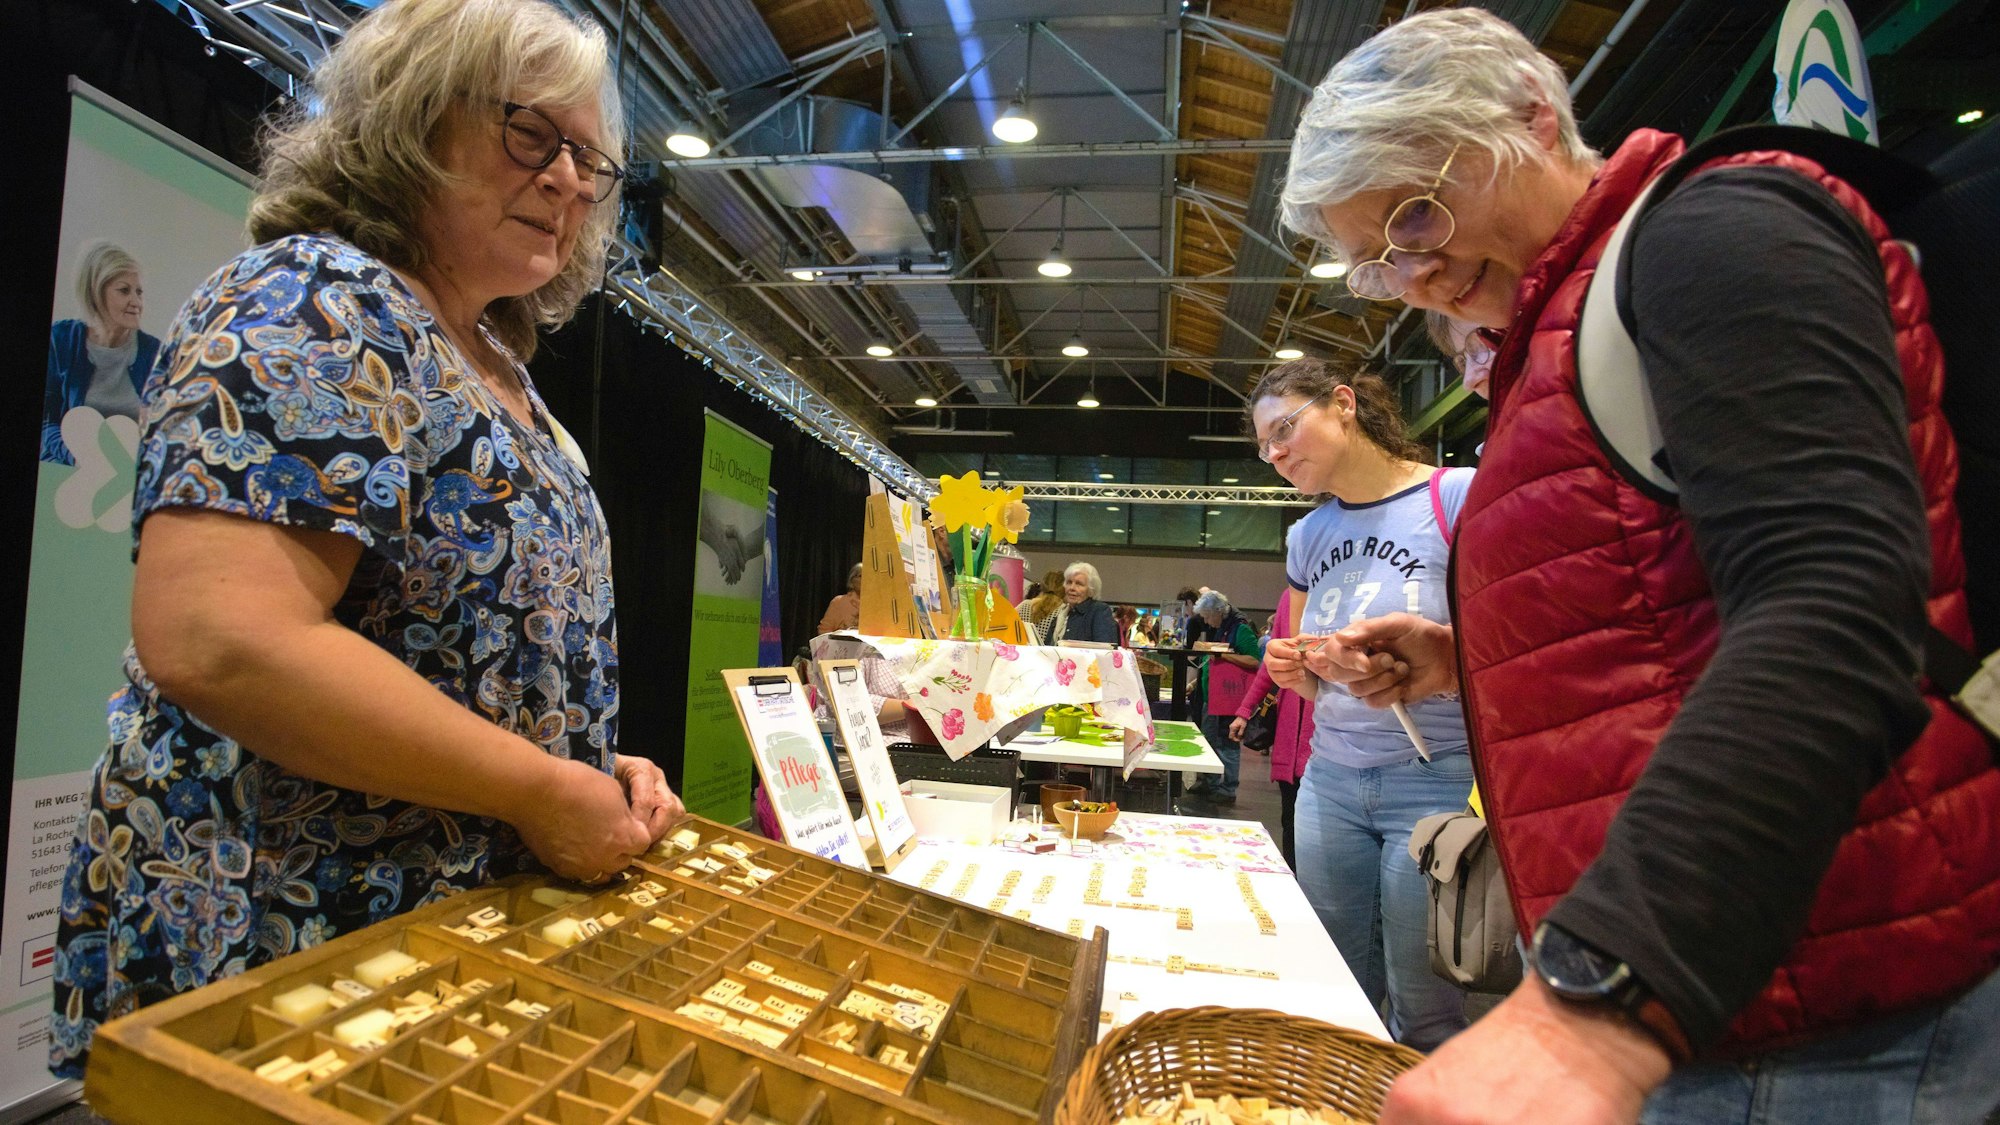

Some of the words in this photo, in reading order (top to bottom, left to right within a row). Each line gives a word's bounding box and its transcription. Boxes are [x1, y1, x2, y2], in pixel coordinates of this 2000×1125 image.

[709, 449, 726, 479] Lily
[728, 459, 764, 495] Oberberg
[1311, 539, 1353, 588] HARD
[1363, 536, 1426, 579] ROCK
[779, 756, 821, 792] Pflege
[35, 798, 52, 809] IHR
[54, 793, 78, 806] WEG
[33, 815, 77, 831] Kontaktb
[32, 836, 43, 845] La
[46, 829, 74, 842] Roche
[31, 844, 61, 859] 51643
[64, 842, 71, 852] G
[30, 864, 65, 878] Telefon
[29, 877, 64, 894] pfleges
[27, 906, 61, 920] www.p
